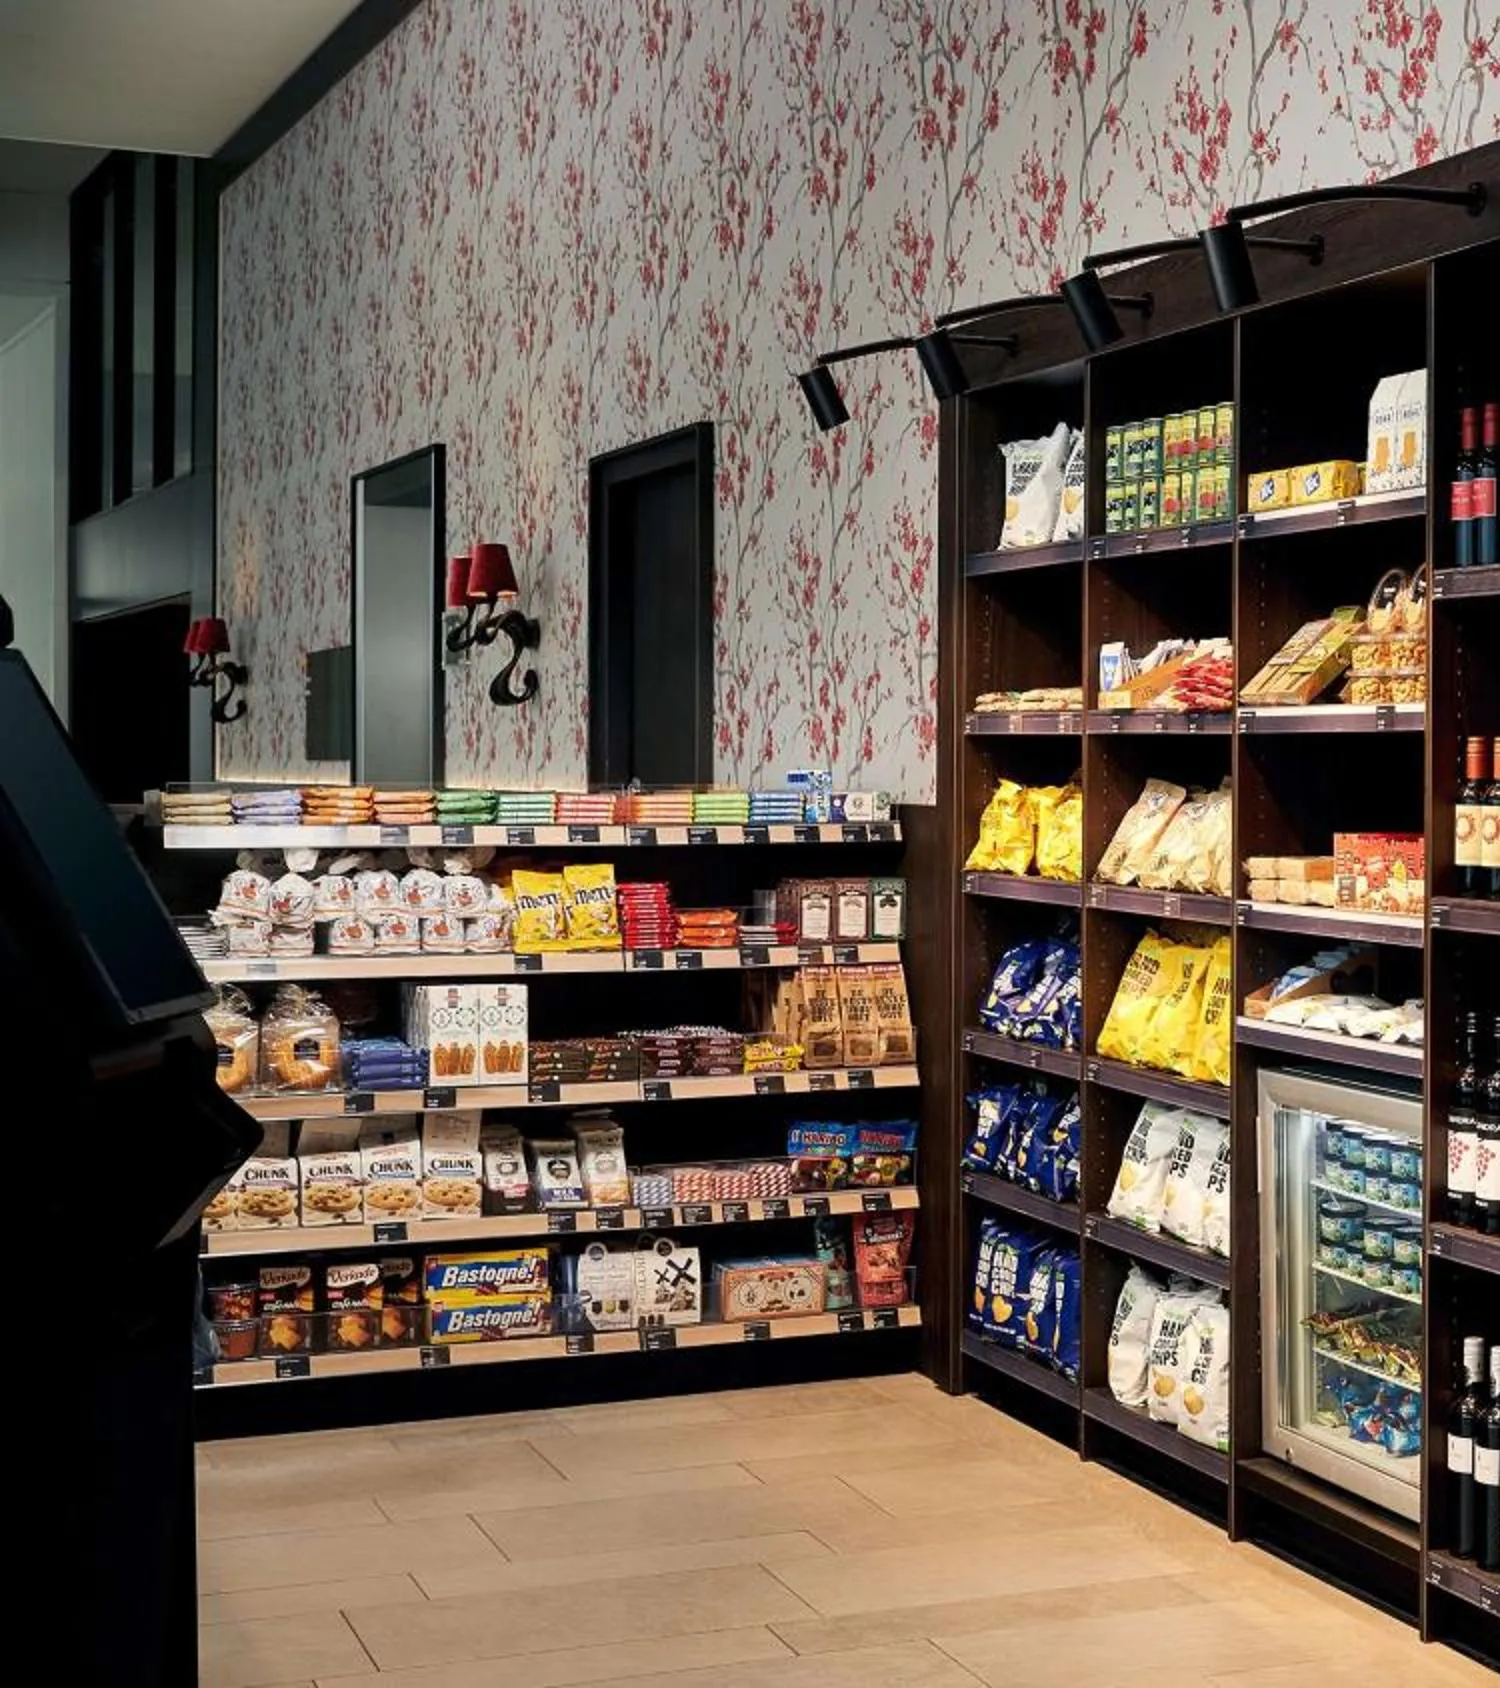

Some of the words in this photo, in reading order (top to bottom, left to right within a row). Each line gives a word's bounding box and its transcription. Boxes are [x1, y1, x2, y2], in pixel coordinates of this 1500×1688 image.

[308, 1163, 353, 1176] CHUNK
[370, 1161, 413, 1174] CHUNK
[431, 1159, 474, 1170] CHUNK
[244, 1167, 289, 1180] CHUNK
